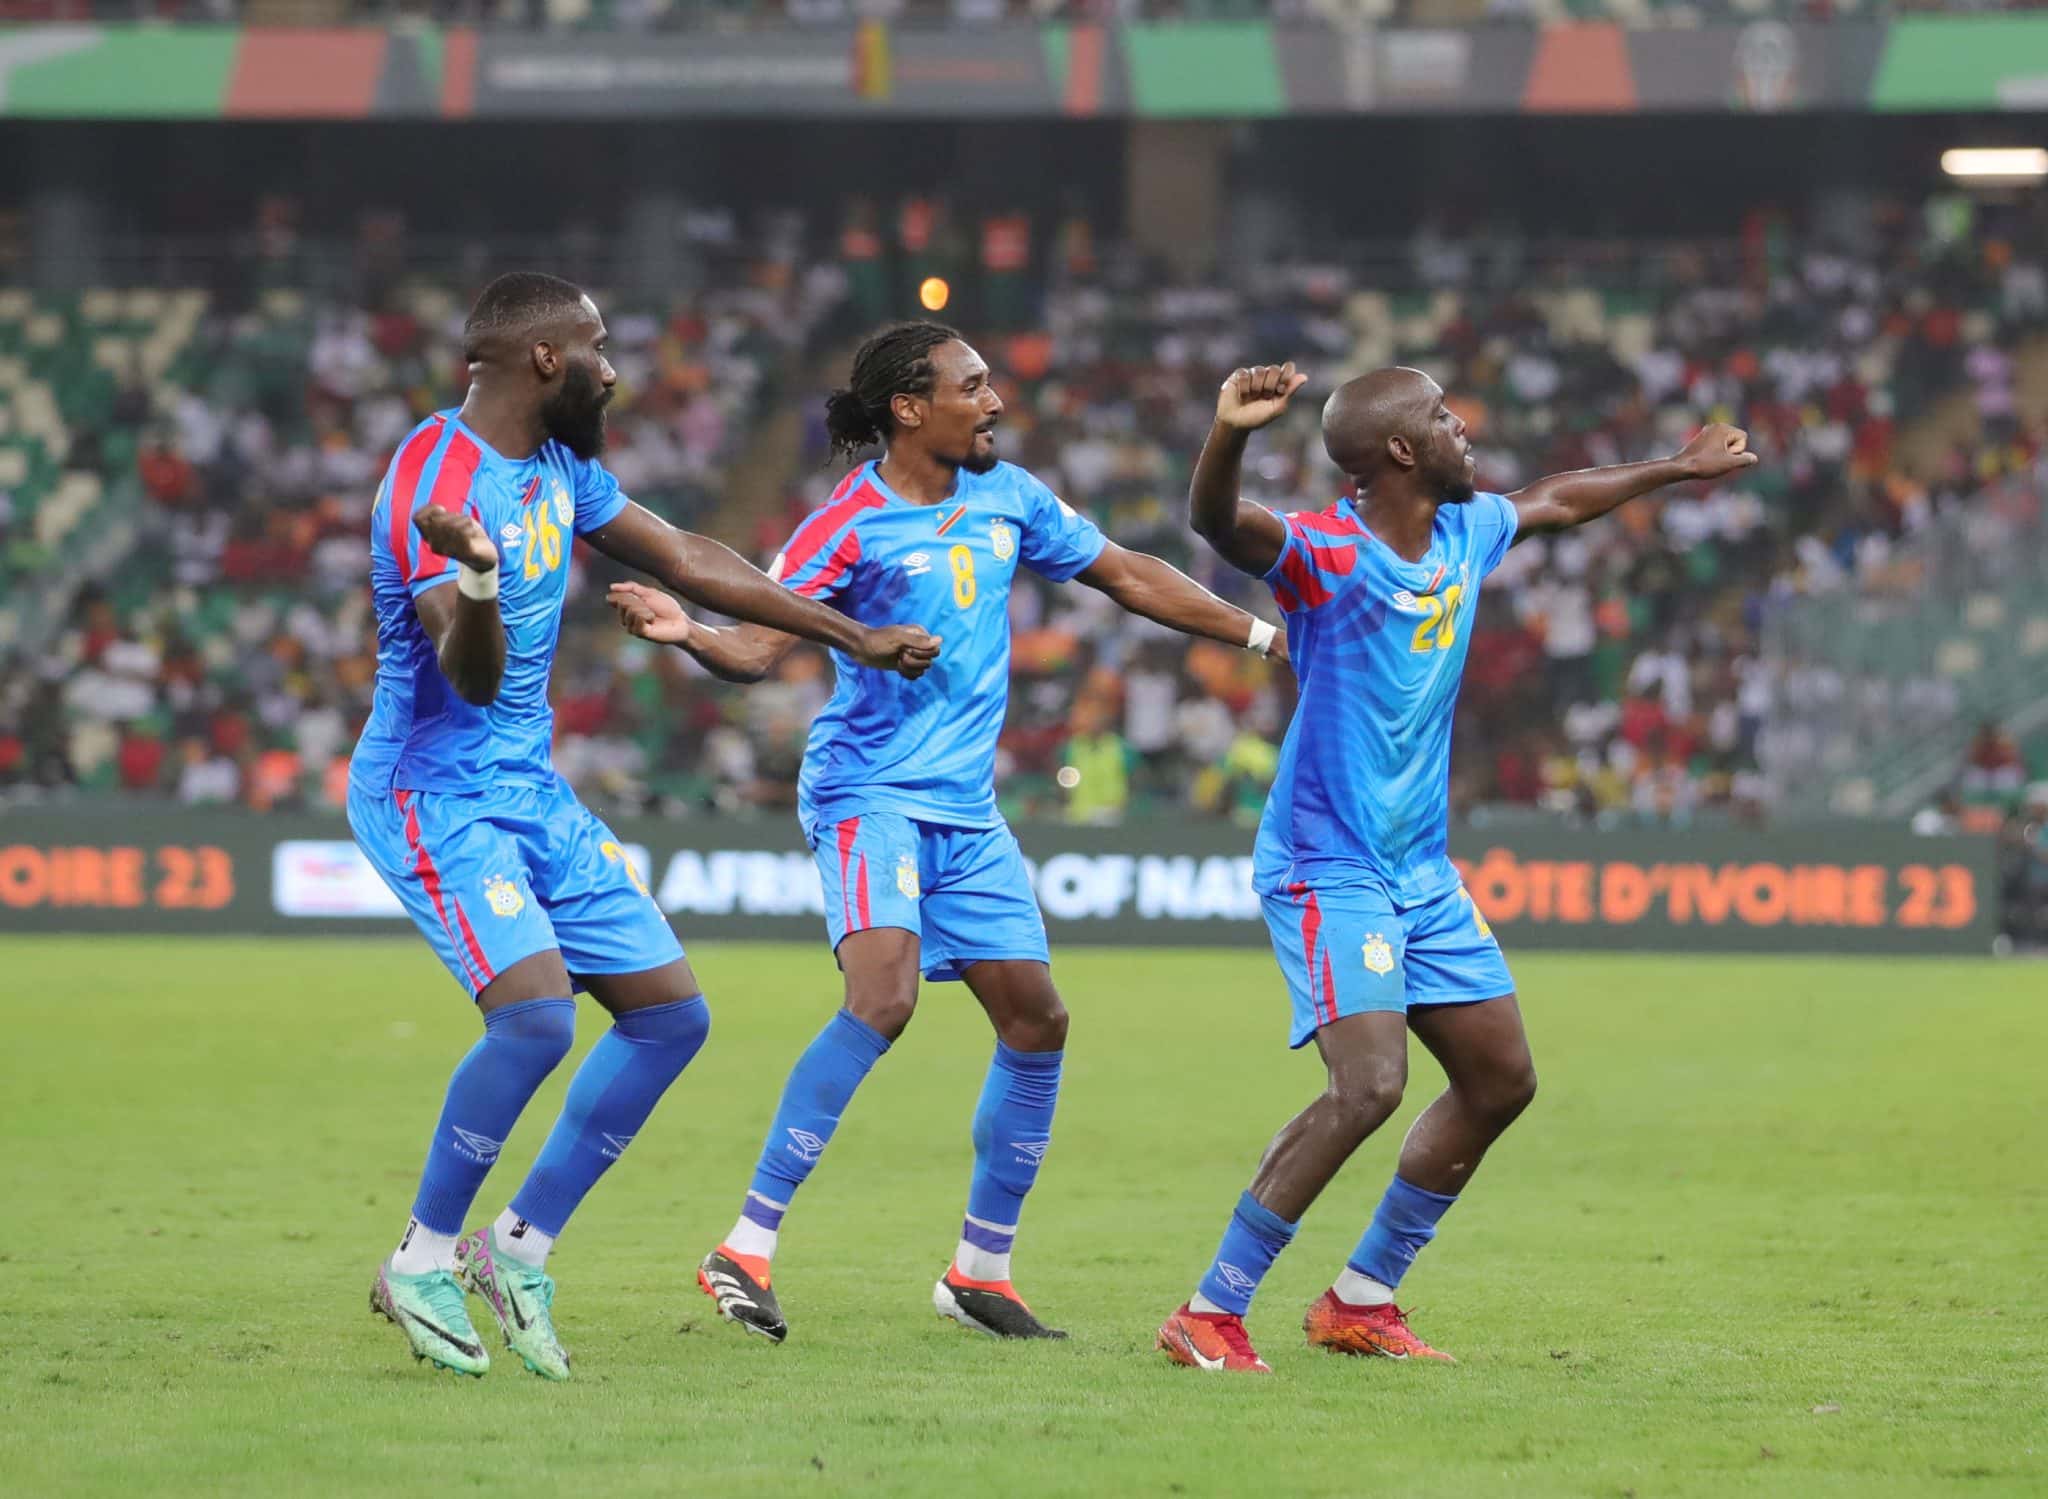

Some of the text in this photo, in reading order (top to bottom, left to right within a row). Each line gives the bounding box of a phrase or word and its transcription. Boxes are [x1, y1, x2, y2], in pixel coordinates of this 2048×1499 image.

[523, 501, 561, 581] 26
[949, 544, 977, 609] 8
[1409, 584, 1461, 652] 20
[154, 844, 235, 910] 23
[658, 849, 828, 915] AFRI
[1039, 853, 1135, 920] OF
[1601, 860, 1888, 925] D'IVOIRE
[1896, 862, 1977, 929] 23
